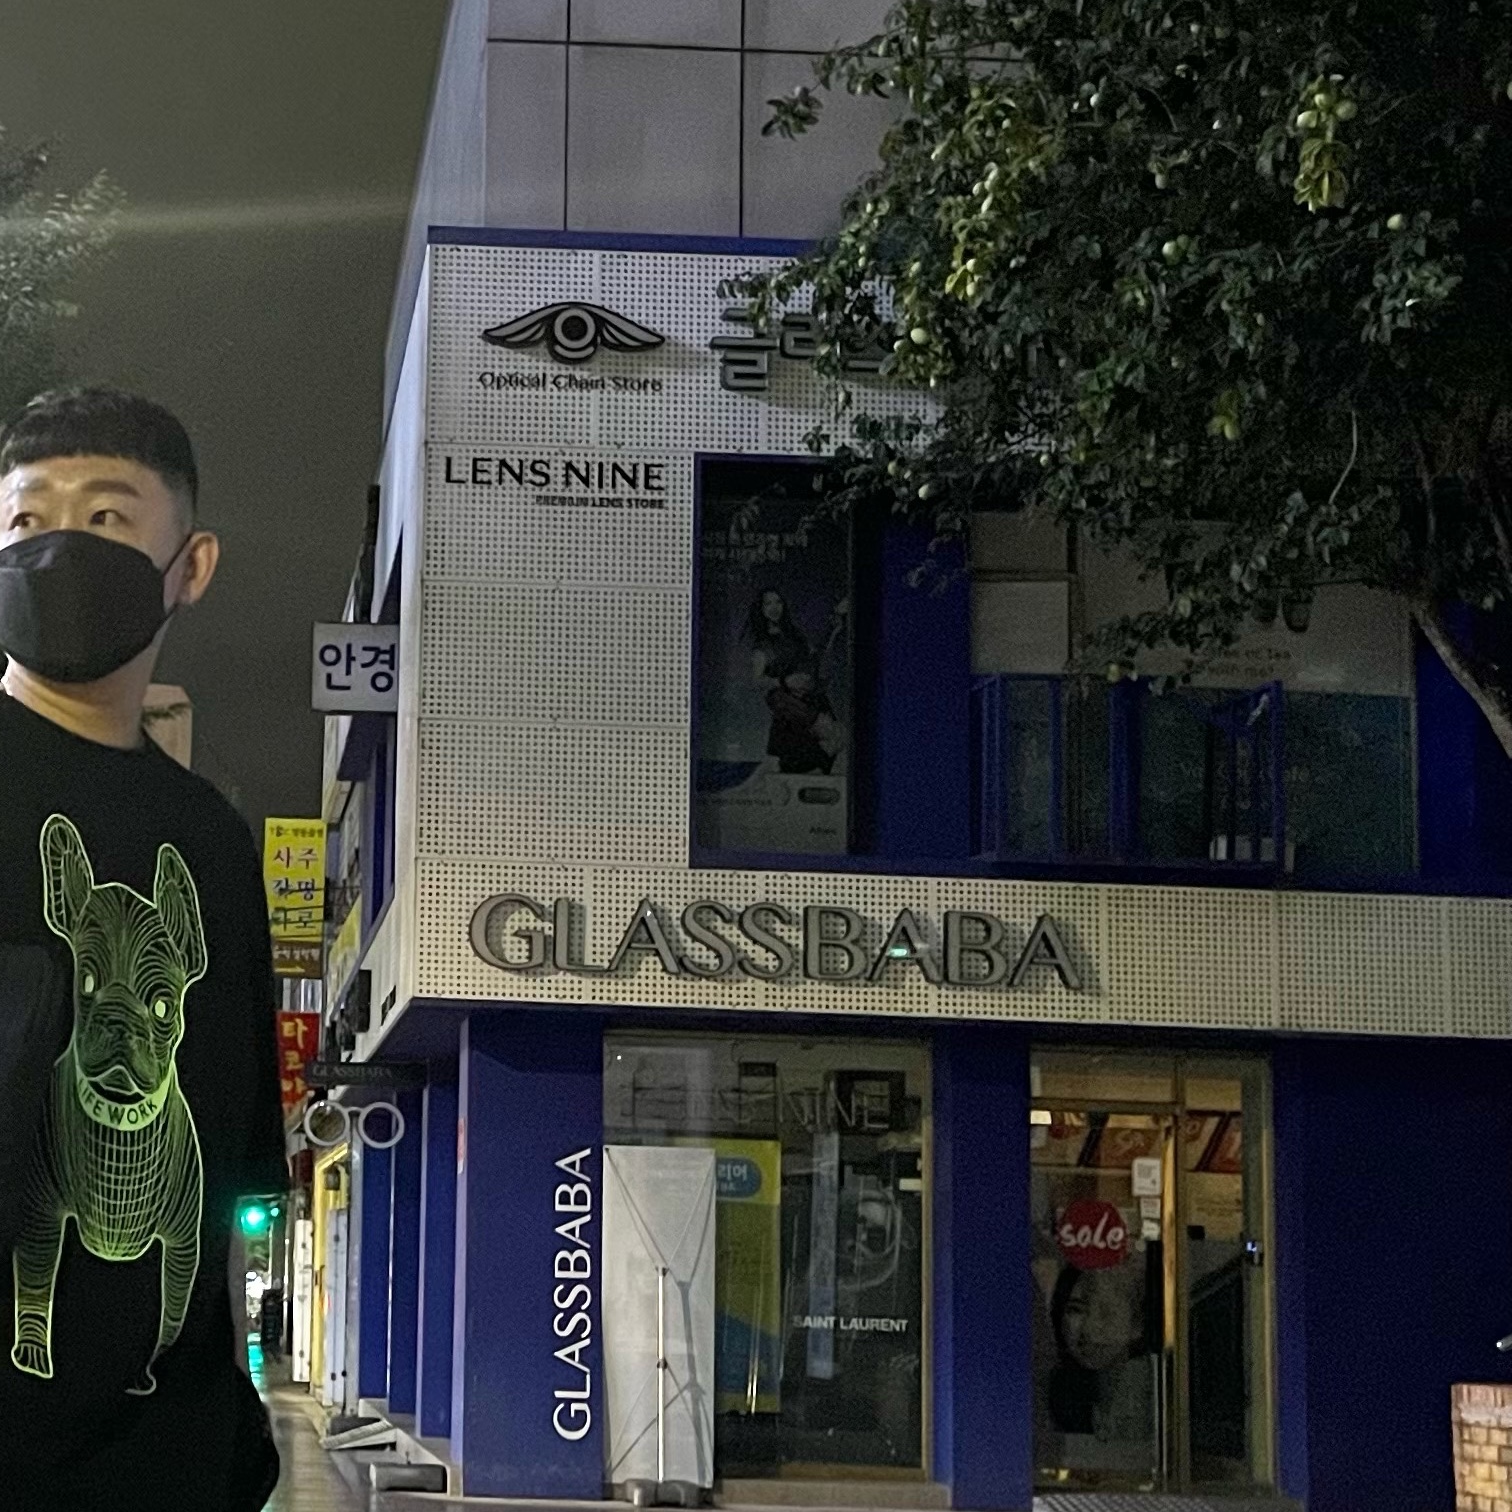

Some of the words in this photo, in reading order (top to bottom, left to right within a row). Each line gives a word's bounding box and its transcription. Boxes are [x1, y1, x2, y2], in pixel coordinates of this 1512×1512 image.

[479, 371, 547, 391] Optical
[552, 373, 606, 391] Chain
[611, 375, 664, 392] Store
[445, 456, 551, 487] LENS
[564, 460, 665, 491] NINE
[318, 642, 396, 694] 안경
[273, 847, 319, 869] 사주
[467, 892, 1085, 992] GLASSBABA
[108, 1099, 158, 1126] WORK
[552, 1146, 593, 1441] GLASSBABA
[792, 1315, 836, 1332] SAINT
[838, 1316, 909, 1333] LAURENT
